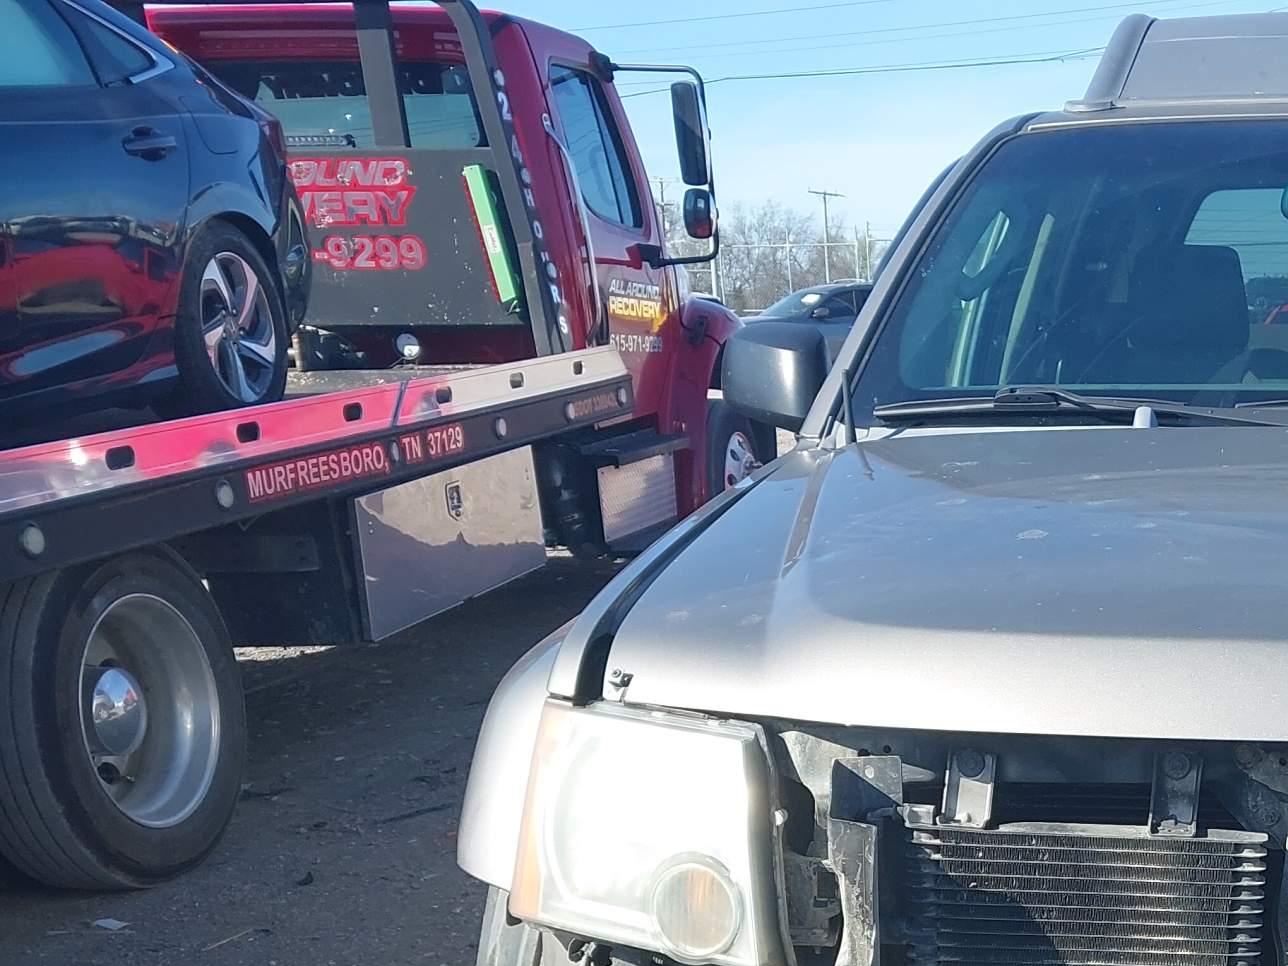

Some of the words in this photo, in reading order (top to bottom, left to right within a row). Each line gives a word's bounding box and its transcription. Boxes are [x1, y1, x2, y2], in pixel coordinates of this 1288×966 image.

[609, 279, 625, 295] ALL
[625, 281, 660, 299] AROUND
[608, 295, 662, 319] RECOVERY
[247, 445, 391, 499] MURFREESBORO,
[402, 436, 421, 461] TN
[428, 425, 464, 456] 37129
